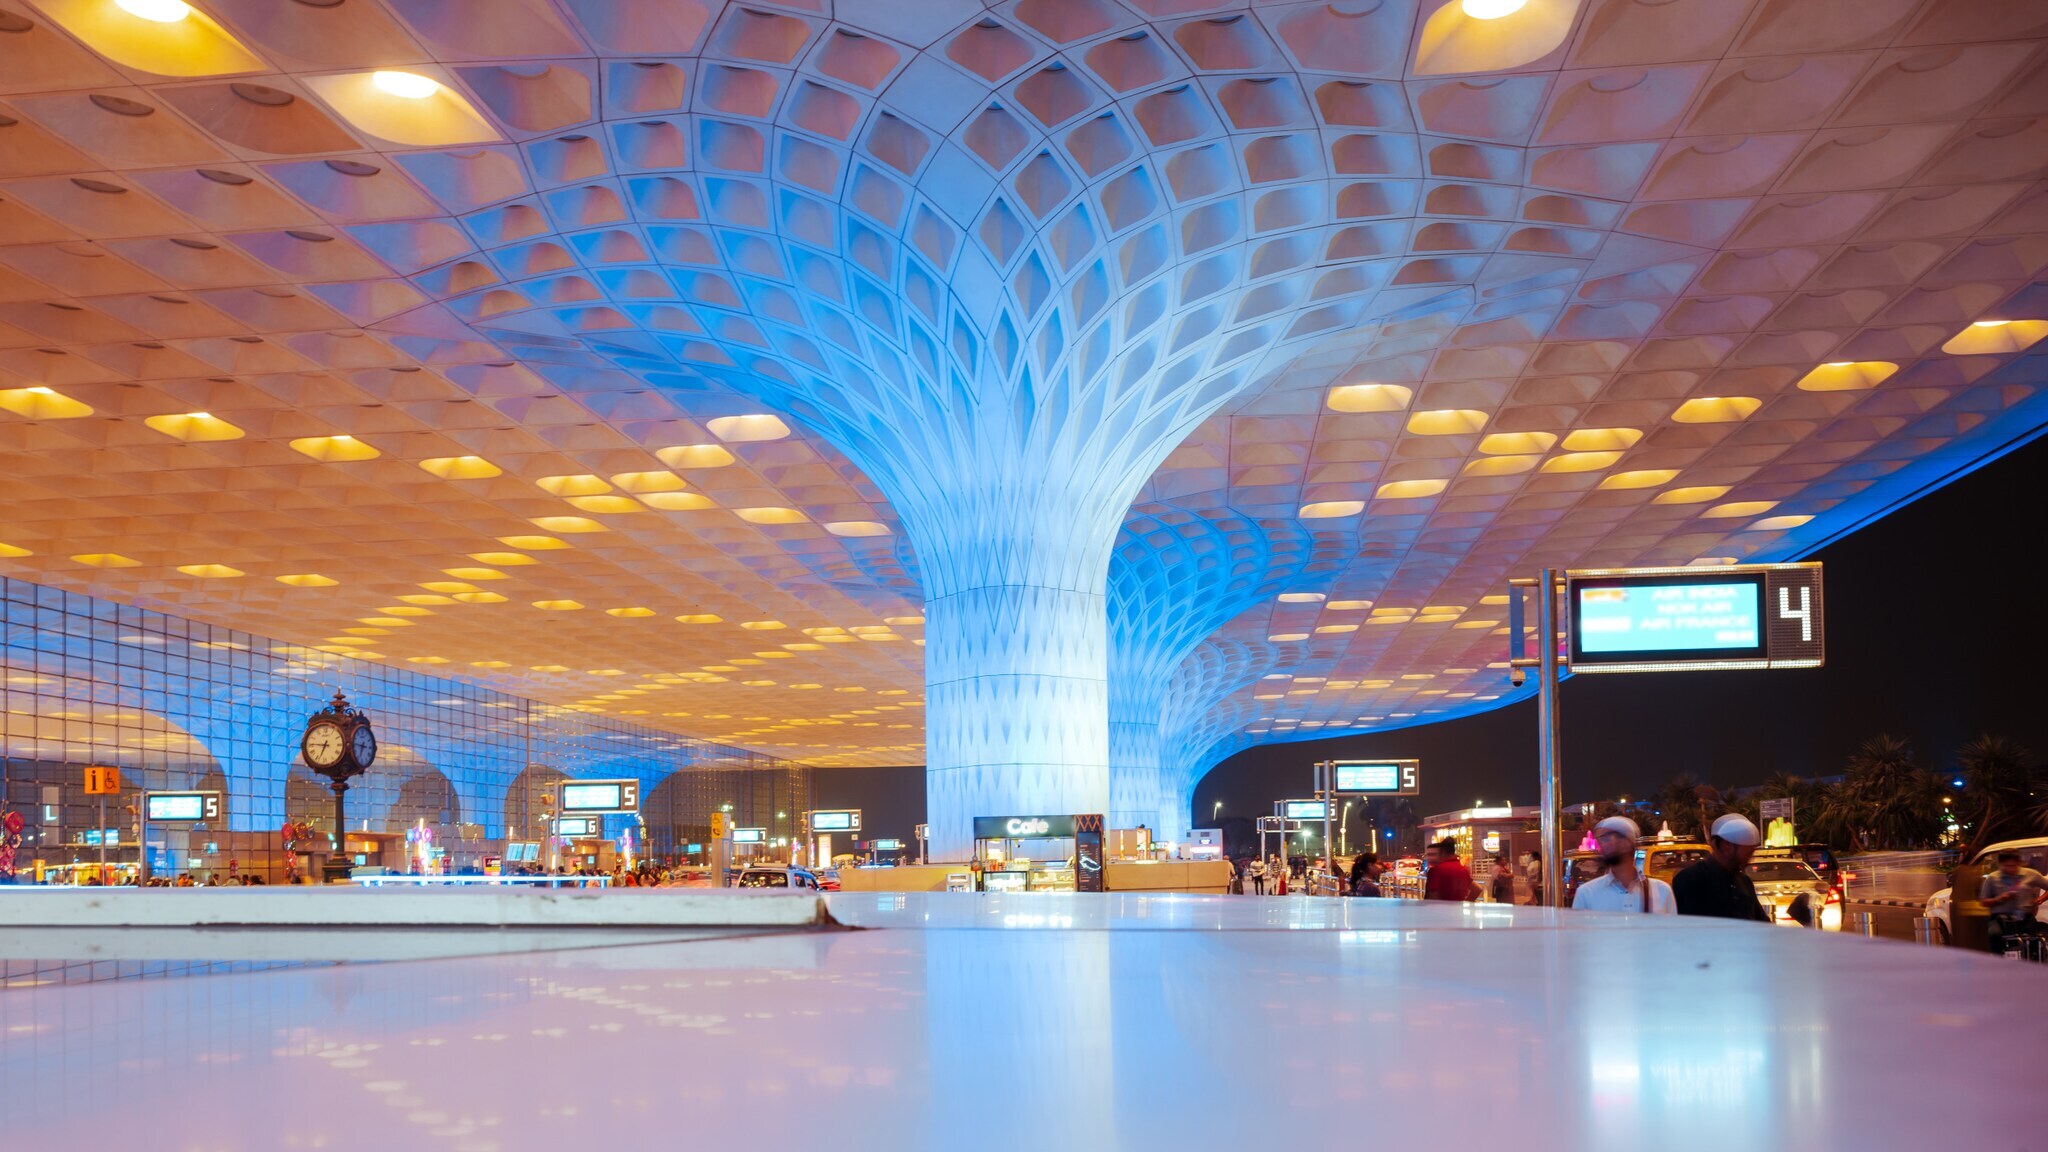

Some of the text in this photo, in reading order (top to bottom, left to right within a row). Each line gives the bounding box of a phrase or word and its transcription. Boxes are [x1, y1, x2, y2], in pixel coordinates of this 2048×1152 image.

[1652, 586, 1738, 601] AIR INDIA
[1639, 616, 1672, 630] AIR
[1674, 615, 1751, 628] FRANCE
[1779, 587, 1811, 641] 4
[1403, 767, 1415, 788] 5
[624, 786, 636, 806] 5
[206, 798, 217, 817] 5
[588, 820, 596, 833] 6
[851, 814, 859, 827] 6
